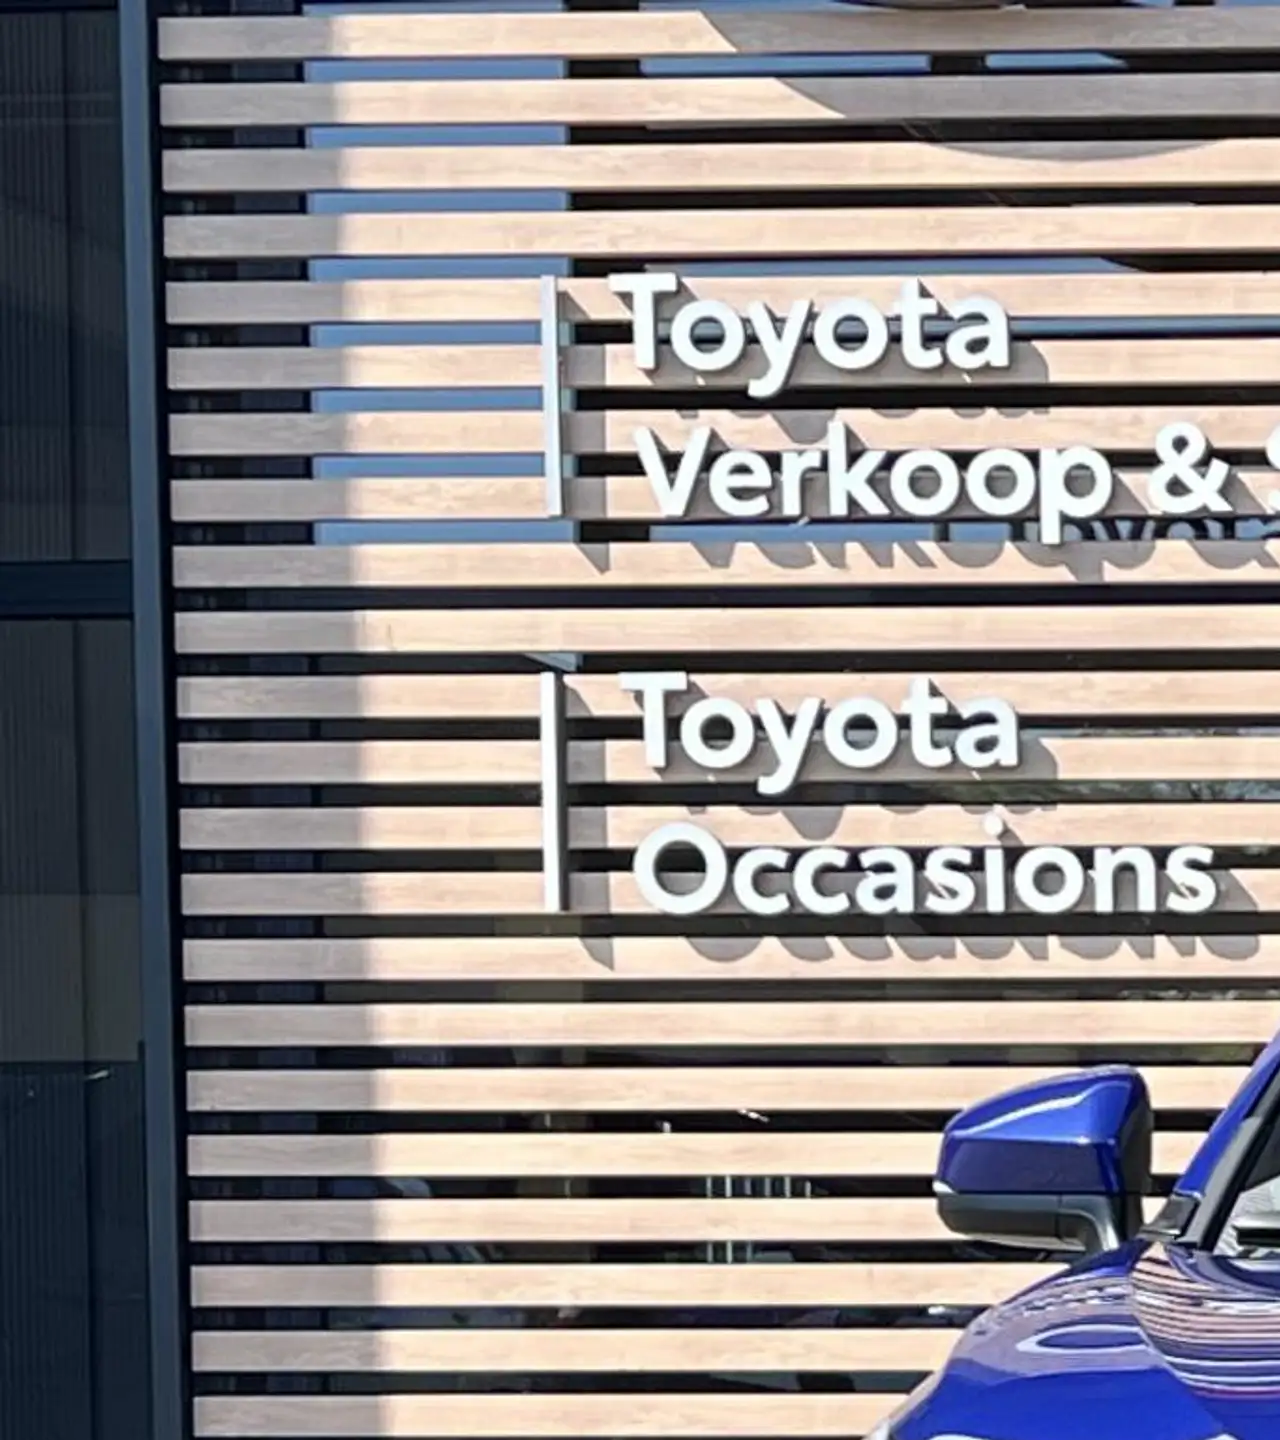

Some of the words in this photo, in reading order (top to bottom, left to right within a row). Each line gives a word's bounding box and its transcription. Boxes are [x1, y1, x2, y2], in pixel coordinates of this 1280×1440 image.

[607, 272, 1011, 398] Toyota
[634, 420, 1113, 545] Verkoop
[1146, 421, 1232, 514] &
[618, 671, 1020, 796] Toyota
[632, 809, 1218, 914] Occasions
